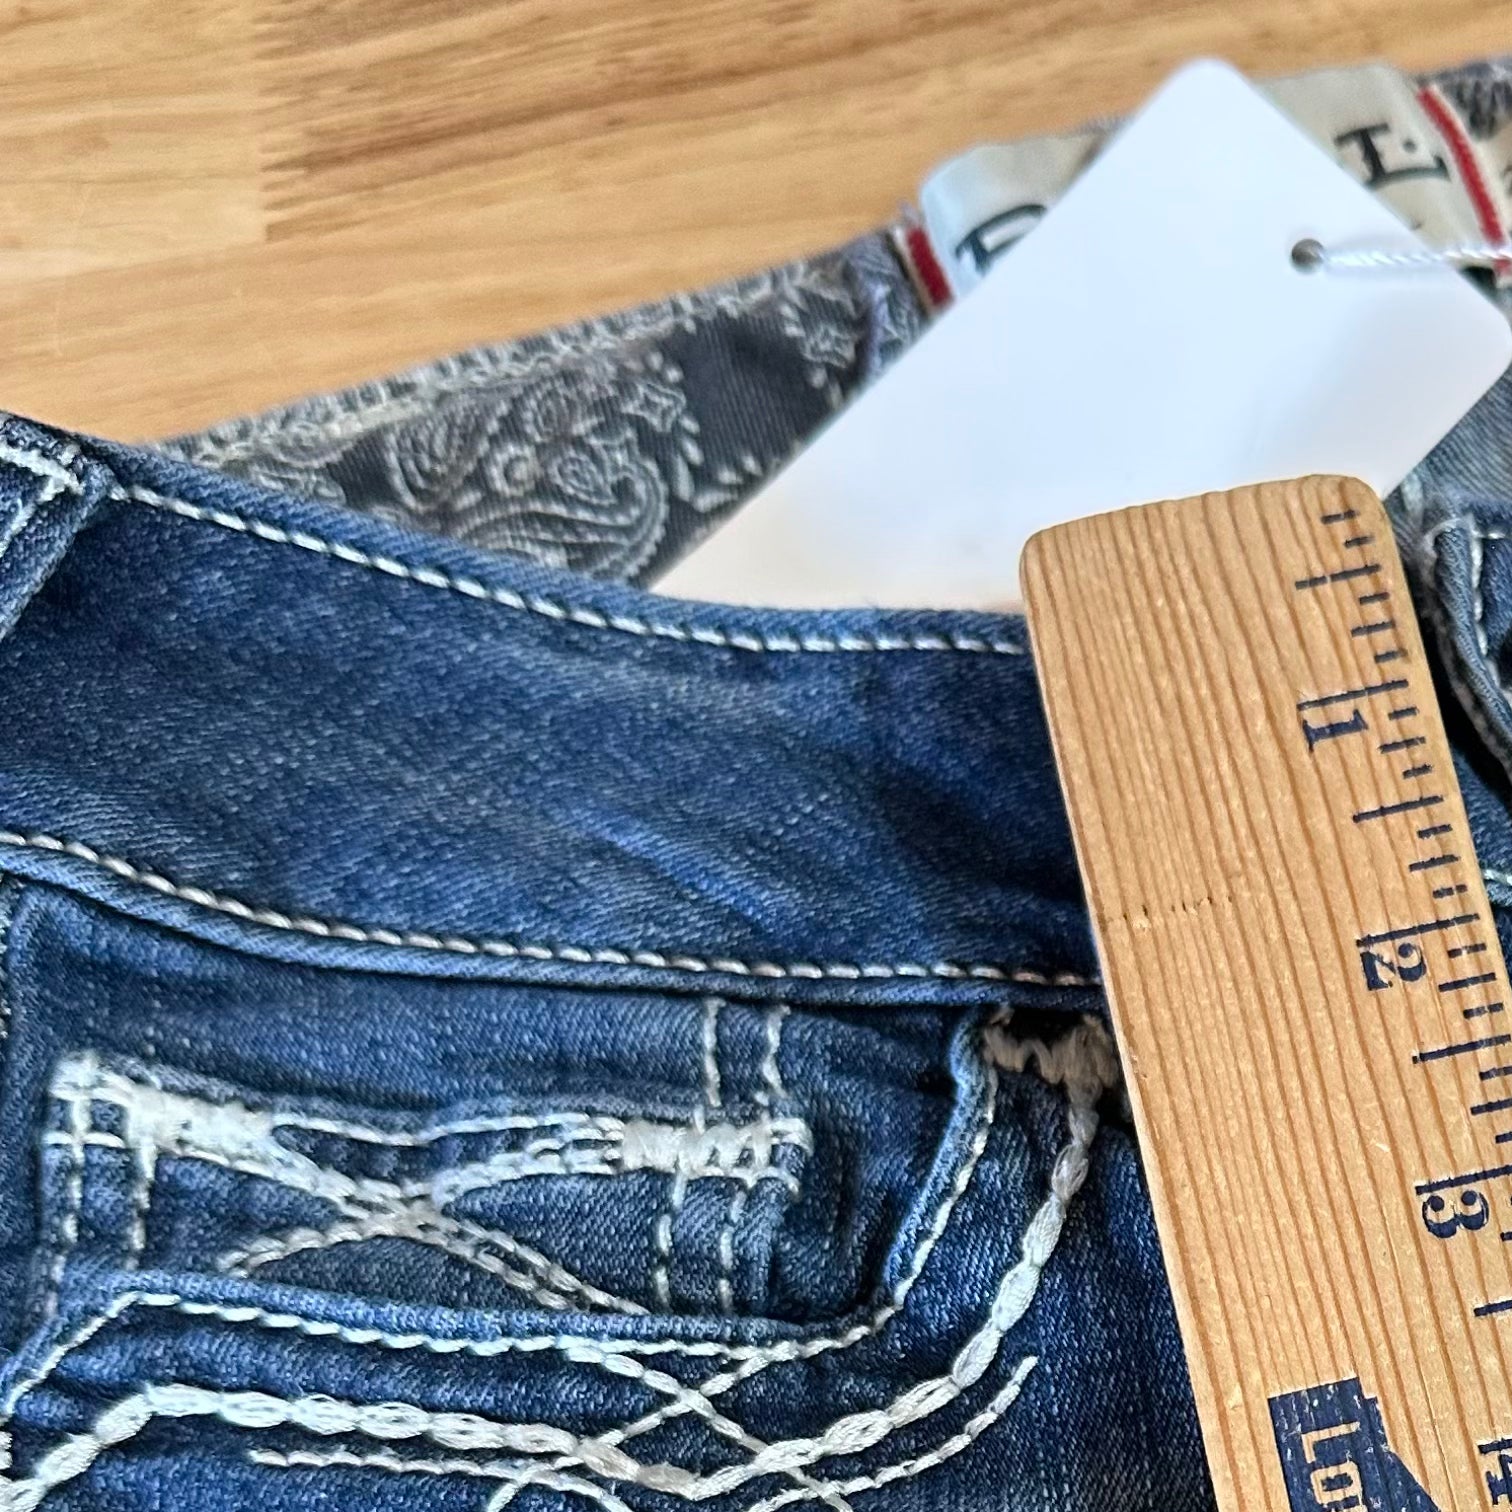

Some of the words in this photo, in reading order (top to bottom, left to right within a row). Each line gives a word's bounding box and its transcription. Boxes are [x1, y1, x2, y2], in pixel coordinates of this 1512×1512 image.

[1302, 708, 1370, 751] 1
[1359, 943, 1428, 990] 2
[1421, 1189, 1489, 1237] 3
